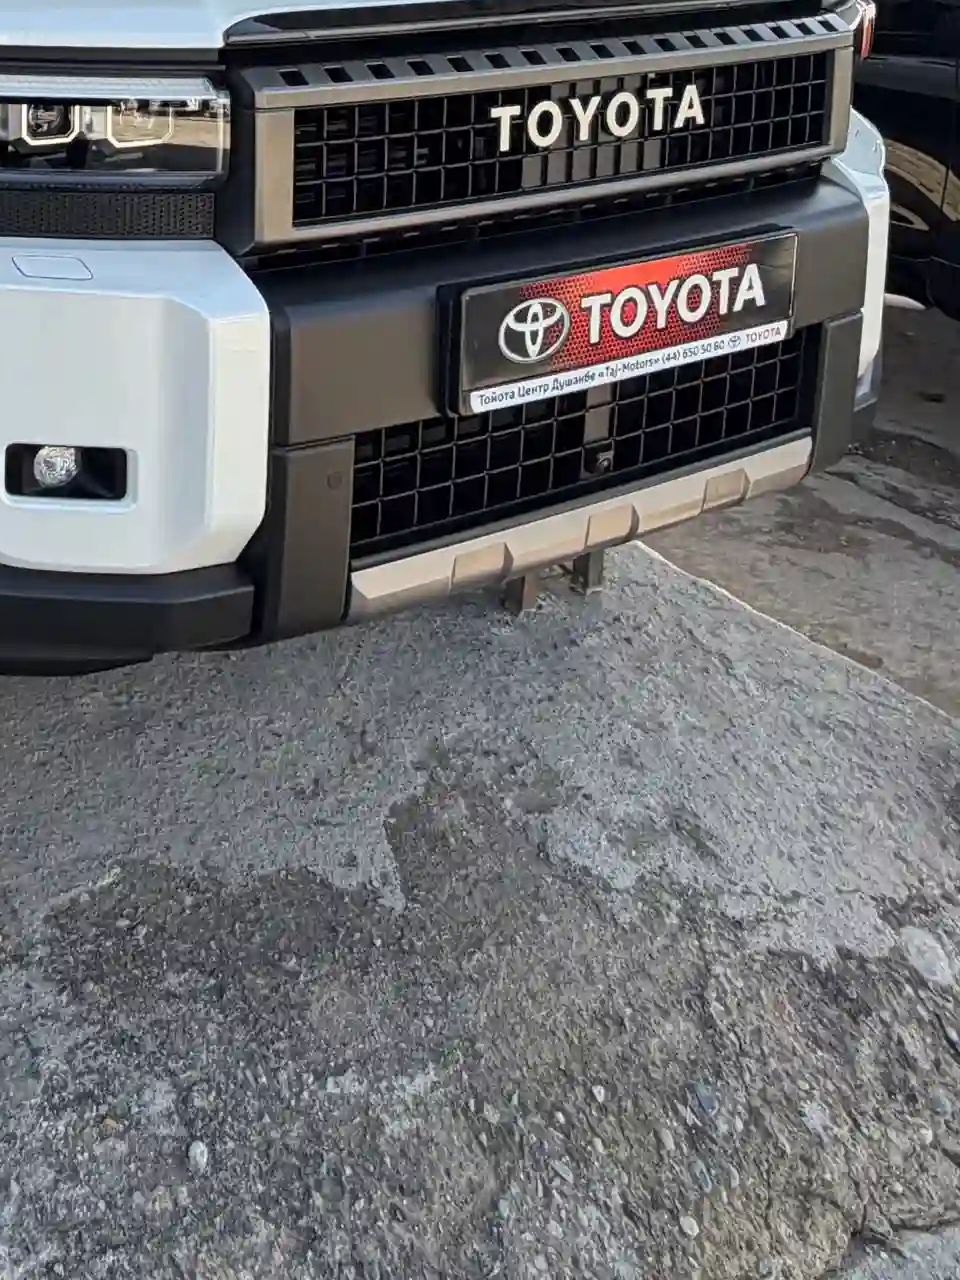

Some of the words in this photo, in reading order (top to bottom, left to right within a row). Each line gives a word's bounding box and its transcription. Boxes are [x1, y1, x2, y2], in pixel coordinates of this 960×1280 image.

[490, 84, 705, 152] TOYOTA
[580, 263, 766, 344] TOYOTA
[478, 389, 515, 407] Тойота
[517, 383, 550, 399] Центр
[551, 372, 596, 393] Душанбе
[661, 350, 681, 366] (44)
[745, 326, 781, 344] TOYOTA
